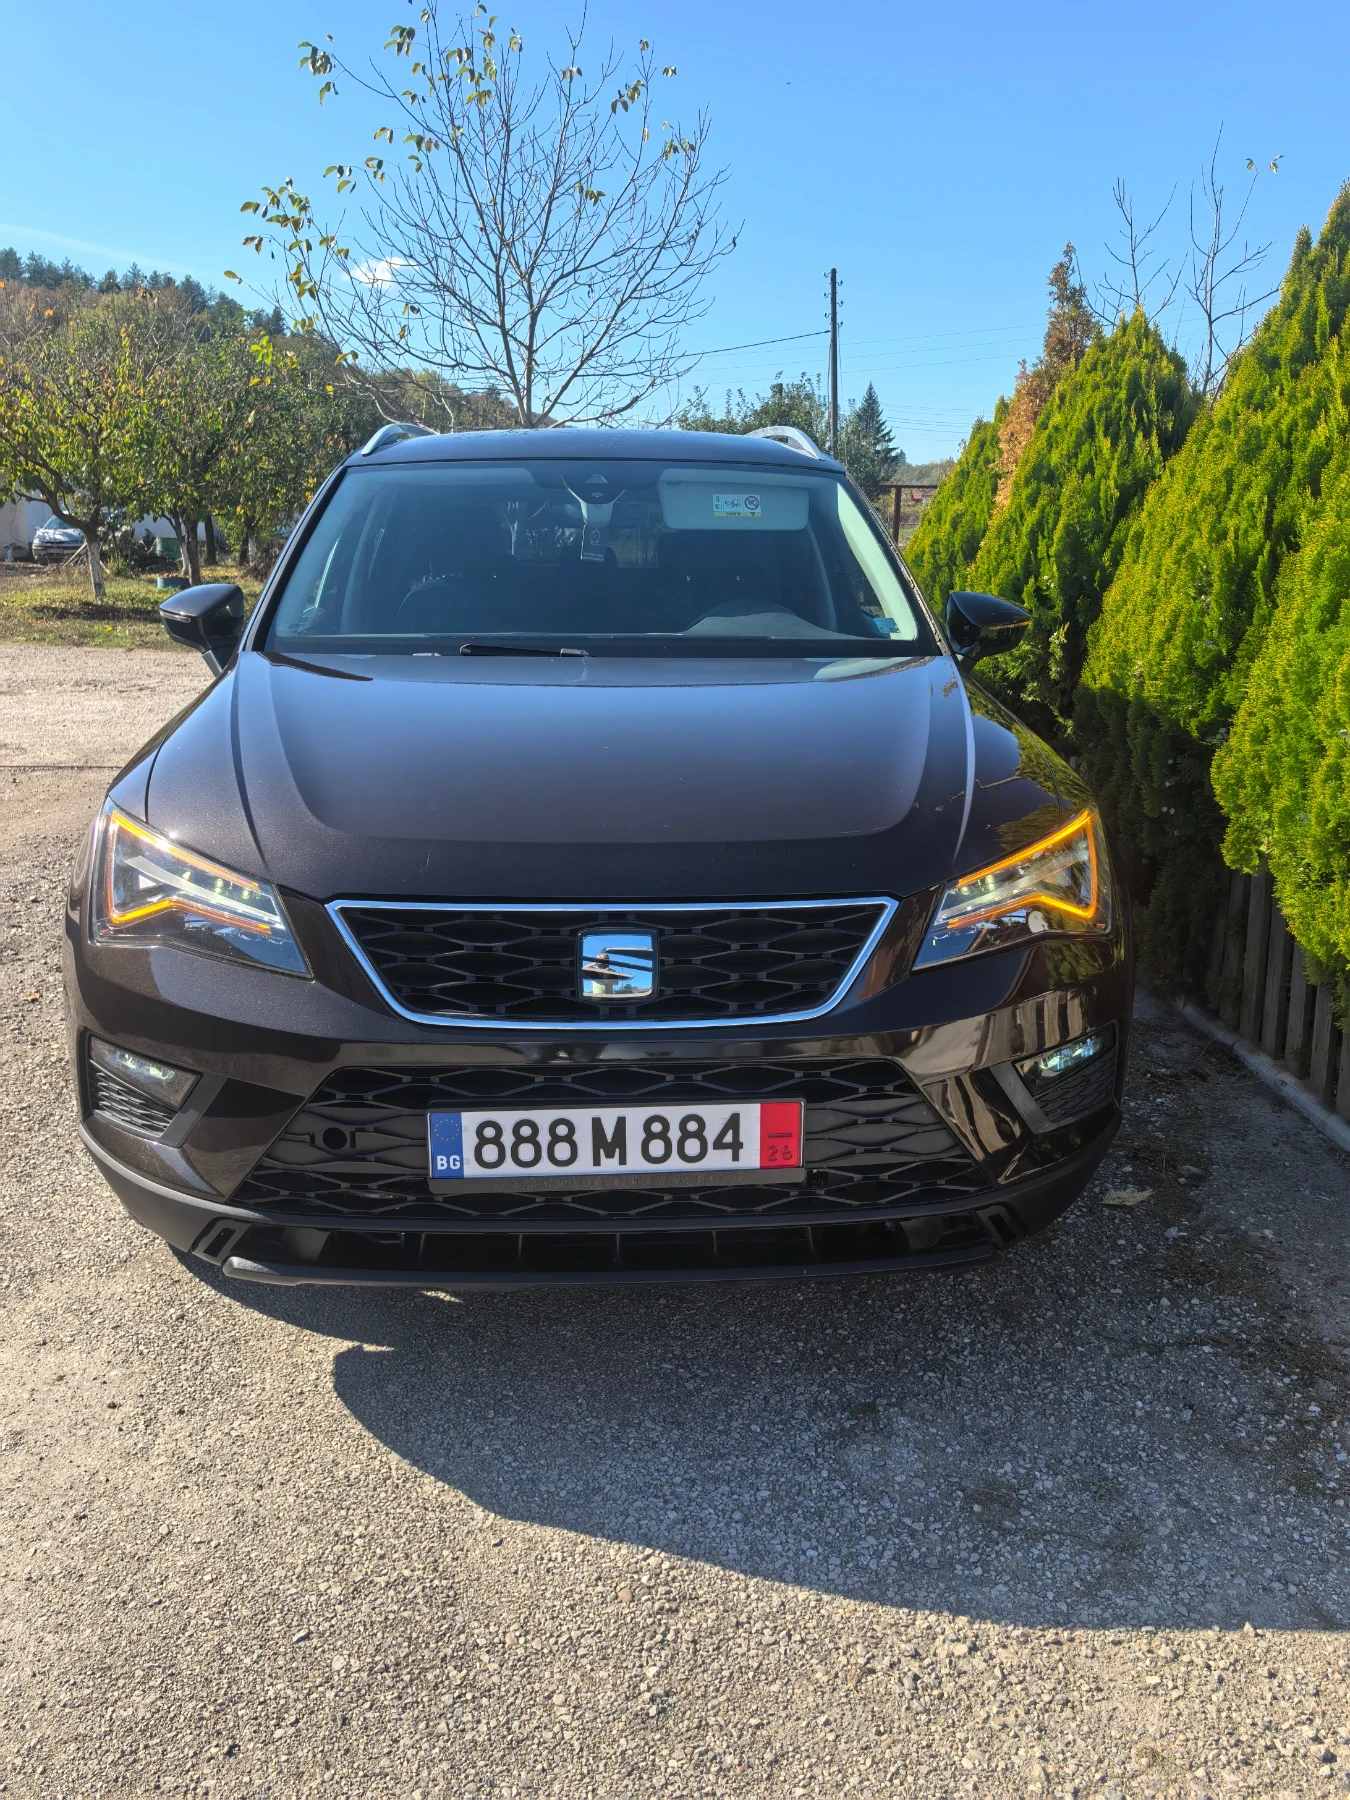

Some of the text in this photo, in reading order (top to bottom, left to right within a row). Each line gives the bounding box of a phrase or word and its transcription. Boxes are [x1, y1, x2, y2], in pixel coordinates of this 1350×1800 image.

[473, 1112, 744, 1170] 888 M 884
[767, 1144, 793, 1162] 26
[436, 1155, 461, 1170] BG
